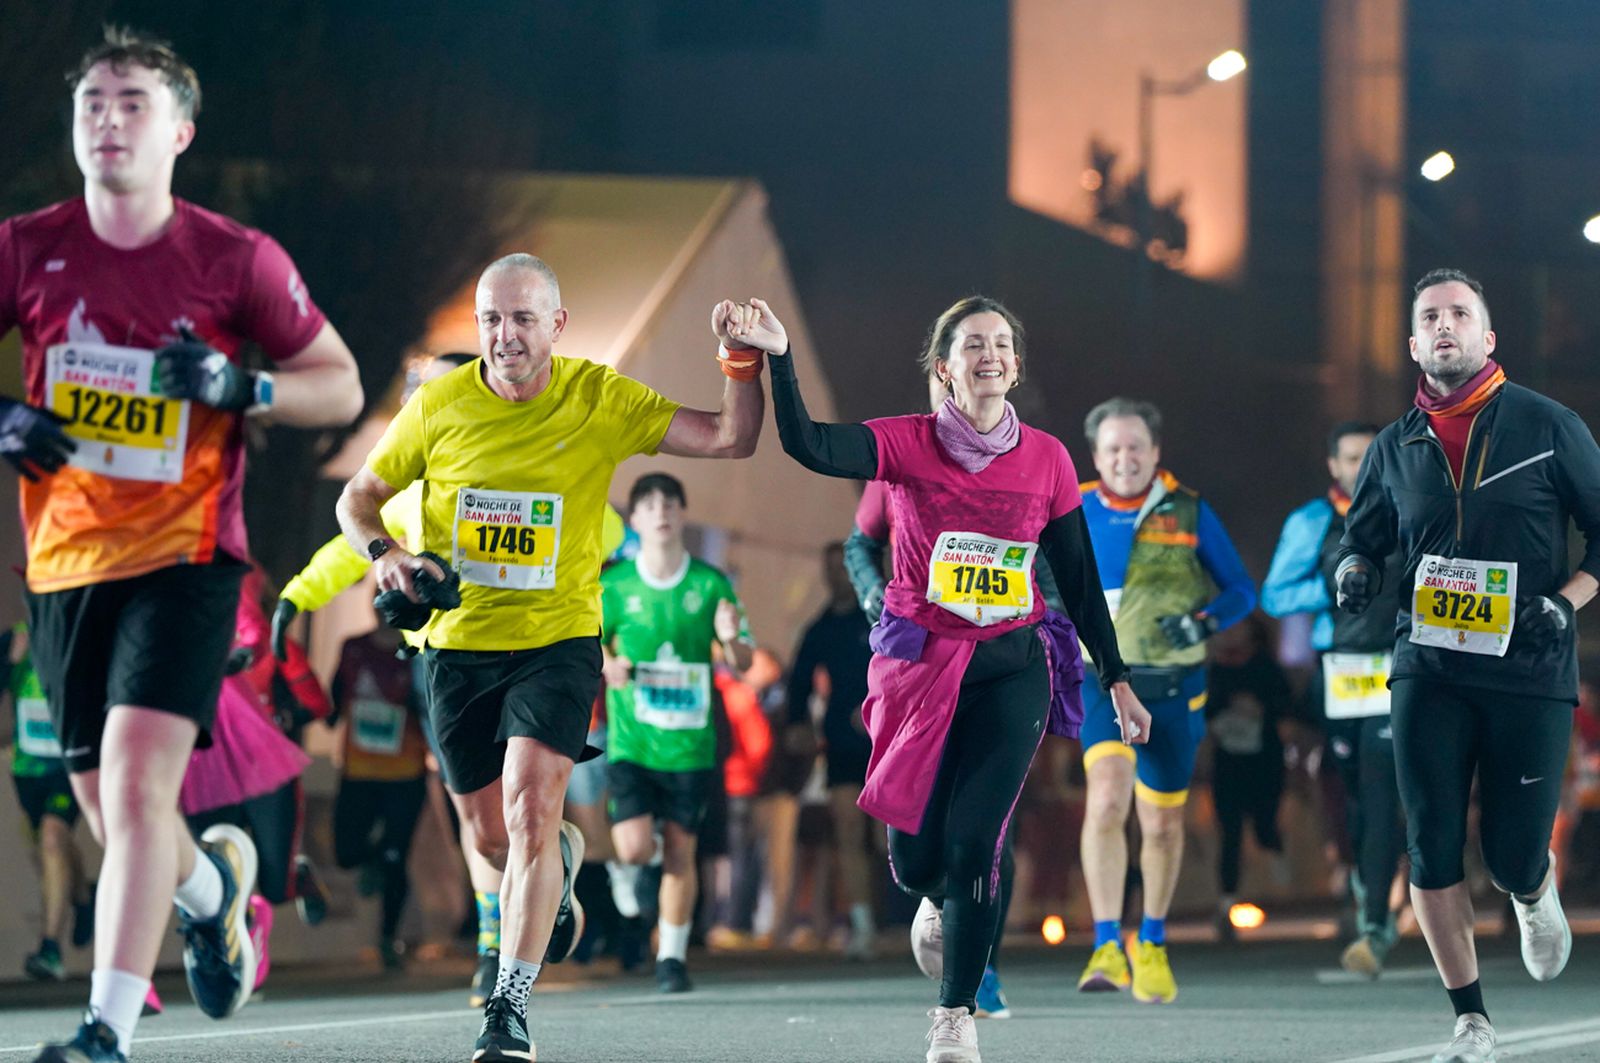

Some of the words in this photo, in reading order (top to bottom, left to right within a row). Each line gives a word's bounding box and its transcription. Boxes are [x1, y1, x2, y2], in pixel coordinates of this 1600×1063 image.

[69, 387, 167, 436] 12261
[476, 501, 508, 511] NOCHE
[510, 502, 522, 512] DE
[465, 510, 484, 520] SAN
[486, 512, 521, 524] ANTÓN
[475, 525, 535, 555] 1746
[956, 542, 984, 553] NOCHE
[985, 545, 998, 554] DE
[943, 552, 962, 562] SAN
[963, 552, 995, 565] ANTÓN
[1437, 567, 1464, 579] NOCHE
[1466, 570, 1477, 580] DE
[953, 566, 1008, 595] 1745
[1424, 576, 1444, 587] SAN
[1432, 590, 1493, 623] 3724
